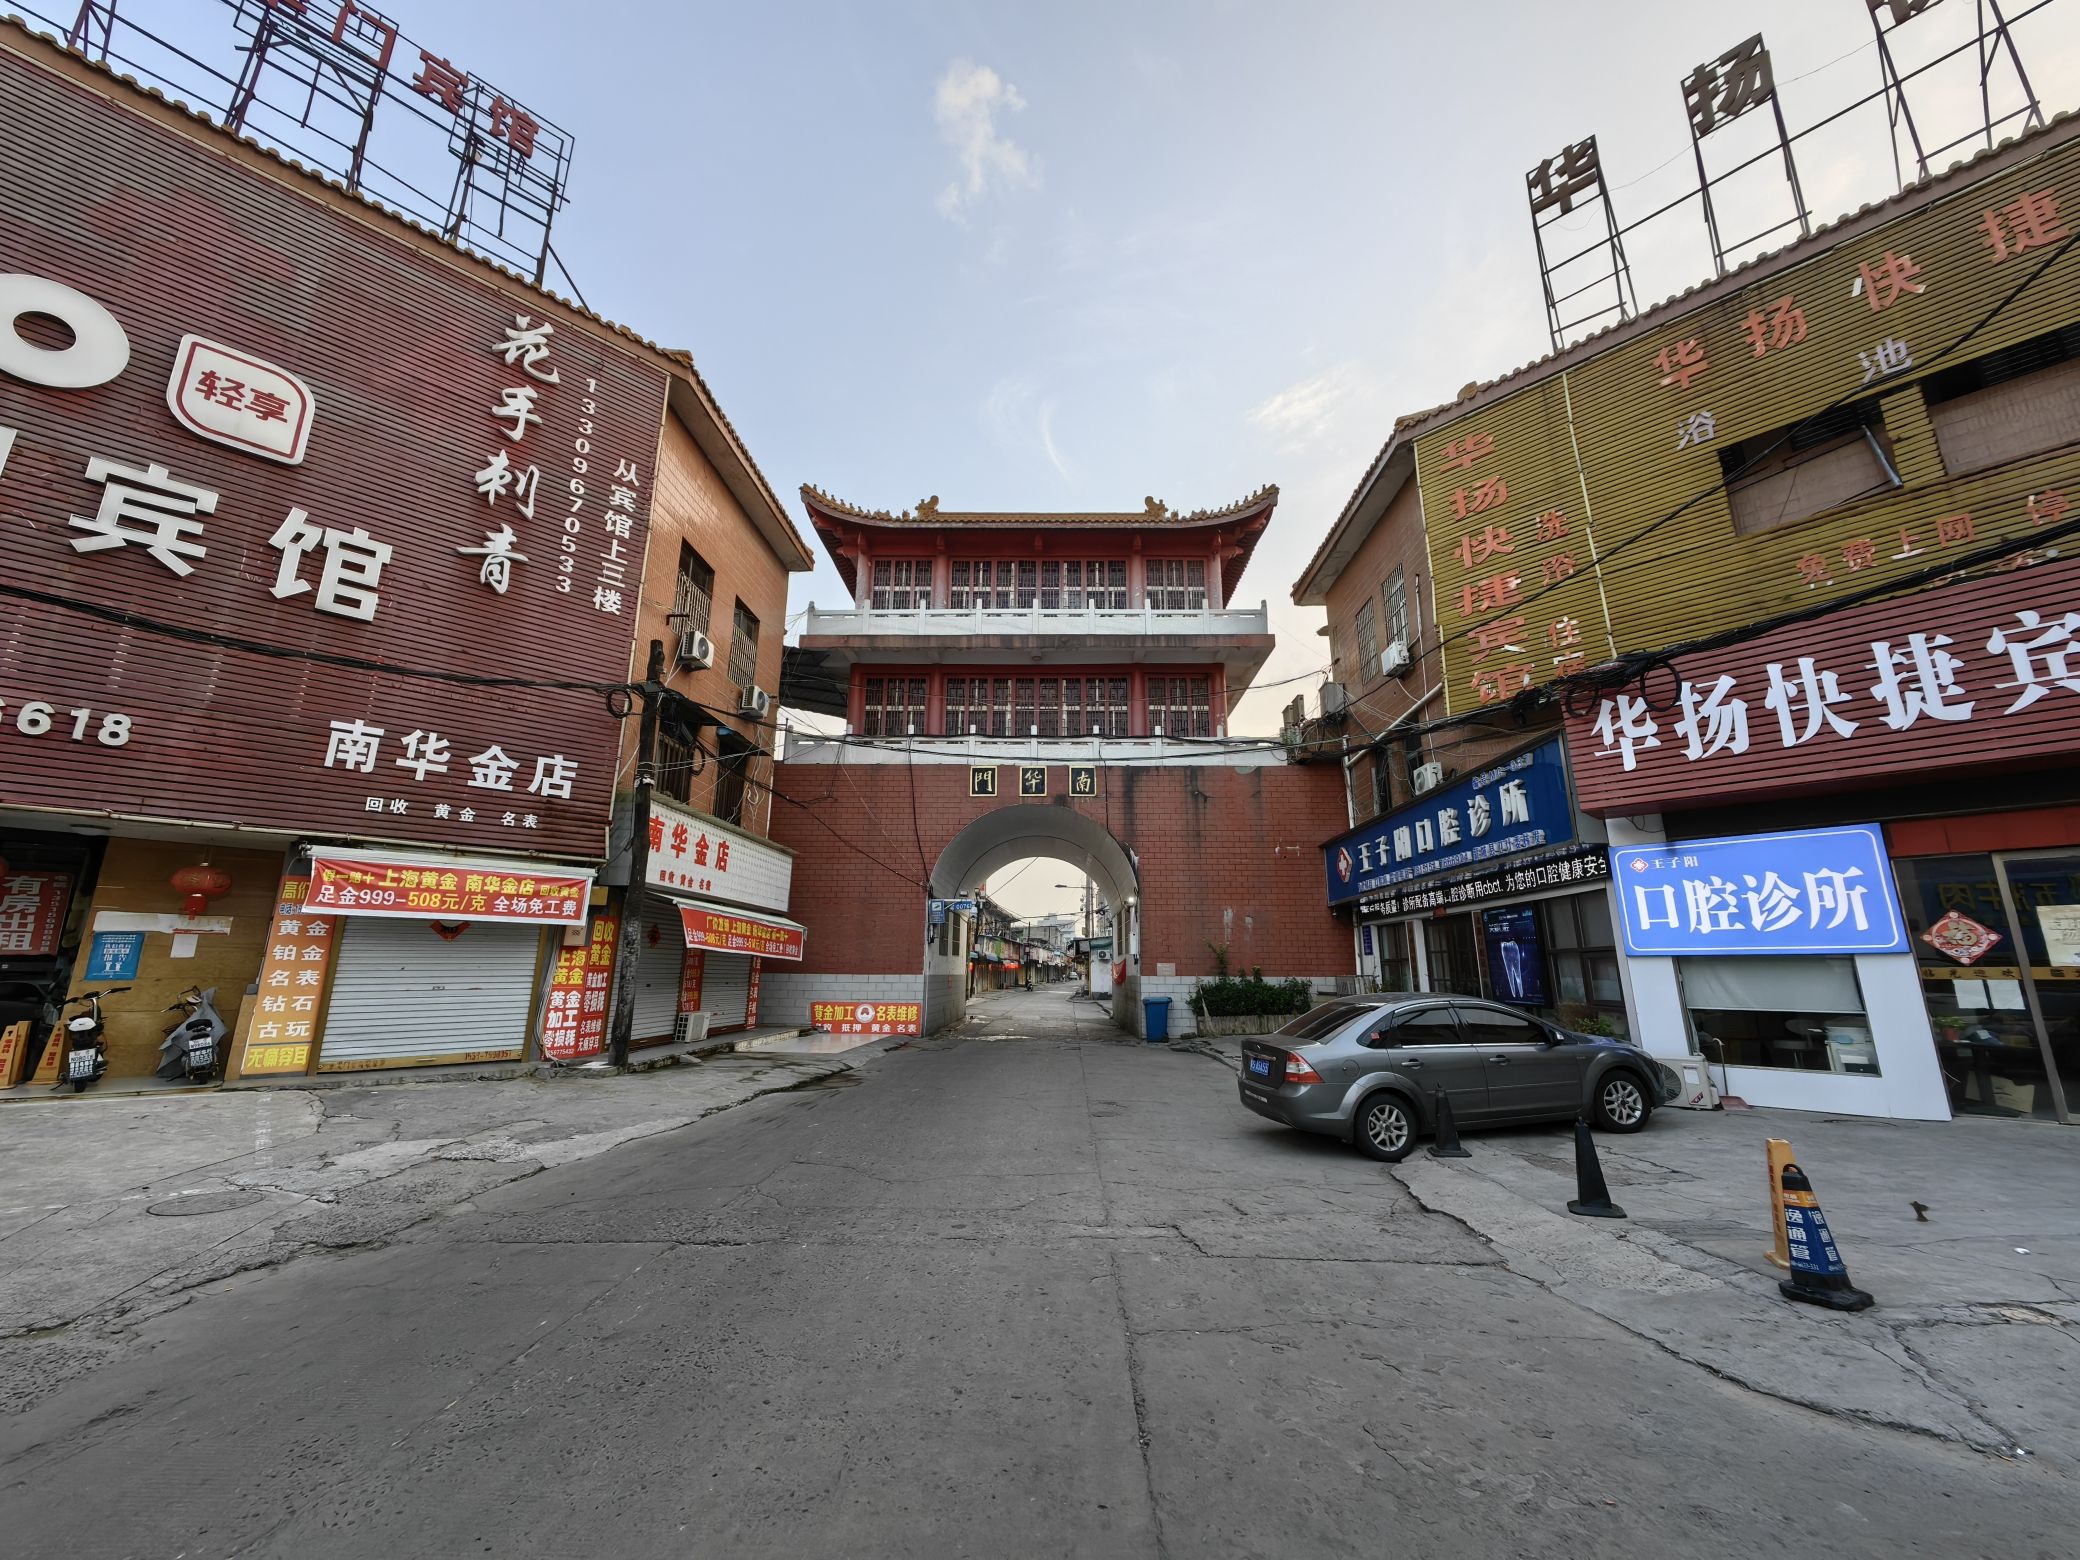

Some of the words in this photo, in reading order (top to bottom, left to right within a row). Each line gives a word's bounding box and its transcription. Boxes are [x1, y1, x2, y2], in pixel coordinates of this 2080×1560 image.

[196, 368, 291, 424] 轻享
[456, 314, 560, 594] 花手刺青
[555, 378, 596, 592] 13309670533
[592, 459, 640, 615] 从宾馆上三楼
[1440, 431, 1535, 703] 华扬快捷宾馆
[324, 719, 579, 799] 南华金店
[365, 796, 409, 816] 回收
[434, 804, 475, 823] 黄金
[501, 809, 540, 830] 名表
[649, 816, 730, 872] 南华金店
[1650, 855, 1699, 869] 王子阳
[379, 869, 457, 890] 上海黄金
[465, 873, 535, 896] 南华金店
[540, 884, 580, 899] 回收黄金
[660, 870, 675, 884] 回收
[680, 874, 694, 888] 黄金
[699, 878, 712, 892] 名表
[493, 896, 577, 916] 全场免工费
[1634, 866, 1869, 934] 口腔诊所
[278, 920, 329, 936] 黄金
[593, 920, 615, 942] 回收
[272, 944, 325, 961] 铂金
[557, 950, 586, 967] 上海
[589, 943, 612, 966] 黄金
[267, 970, 320, 986] 名表
[553, 968, 584, 985] 黄金
[262, 995, 315, 1012] 钻石
[550, 991, 581, 1009] 黄金
[547, 1010, 577, 1028] 加工
[814, 1004, 855, 1021] 黄金加工
[876, 1005, 918, 1021] 名表维修
[258, 1020, 311, 1038] 古玩
[871, 1023, 891, 1033] 黄金
[896, 1023, 917, 1033] 名表
